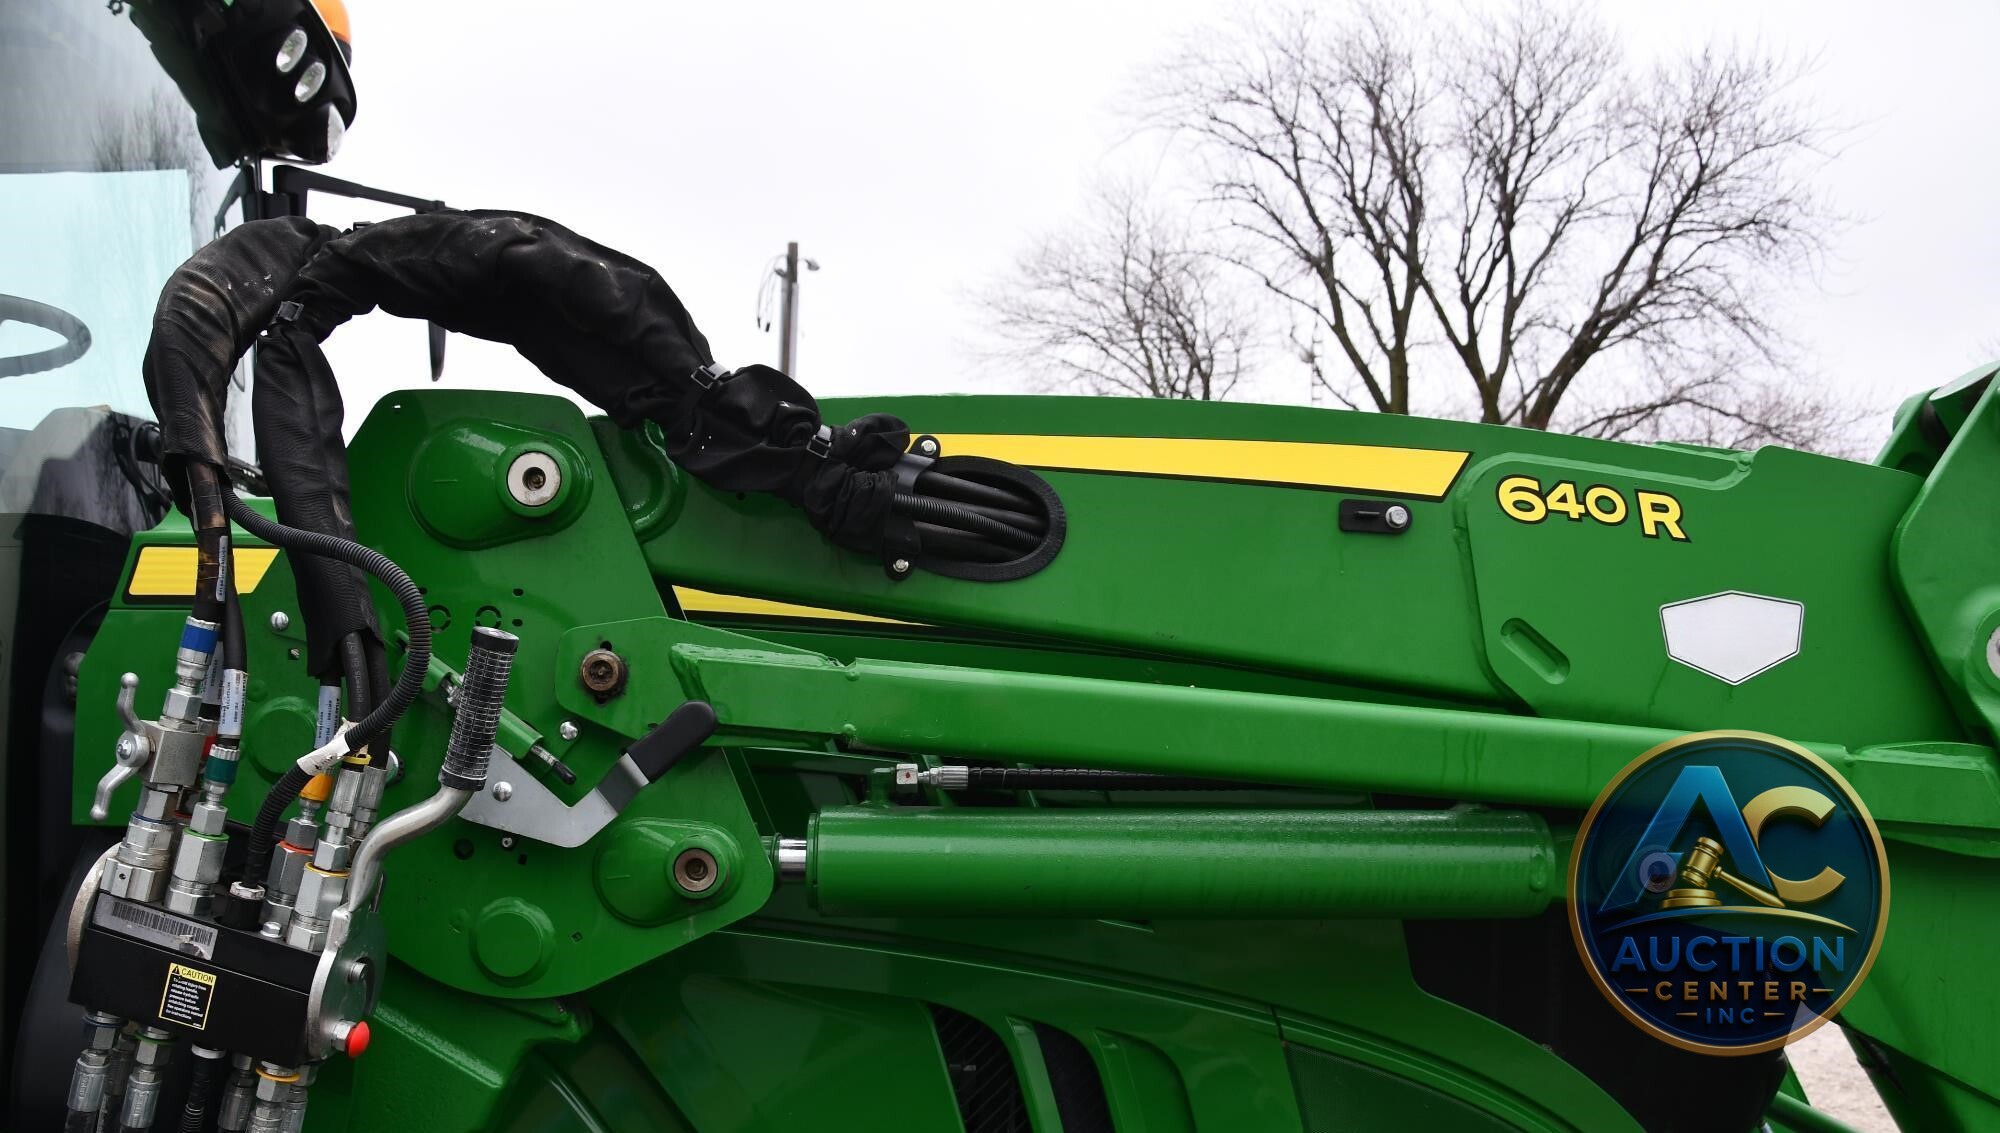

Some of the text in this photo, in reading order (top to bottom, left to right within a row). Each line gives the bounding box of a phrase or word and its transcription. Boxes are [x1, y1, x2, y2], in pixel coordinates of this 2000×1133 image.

[1497, 475, 1690, 543] 640 R
[181, 968, 214, 983] CAUTION
